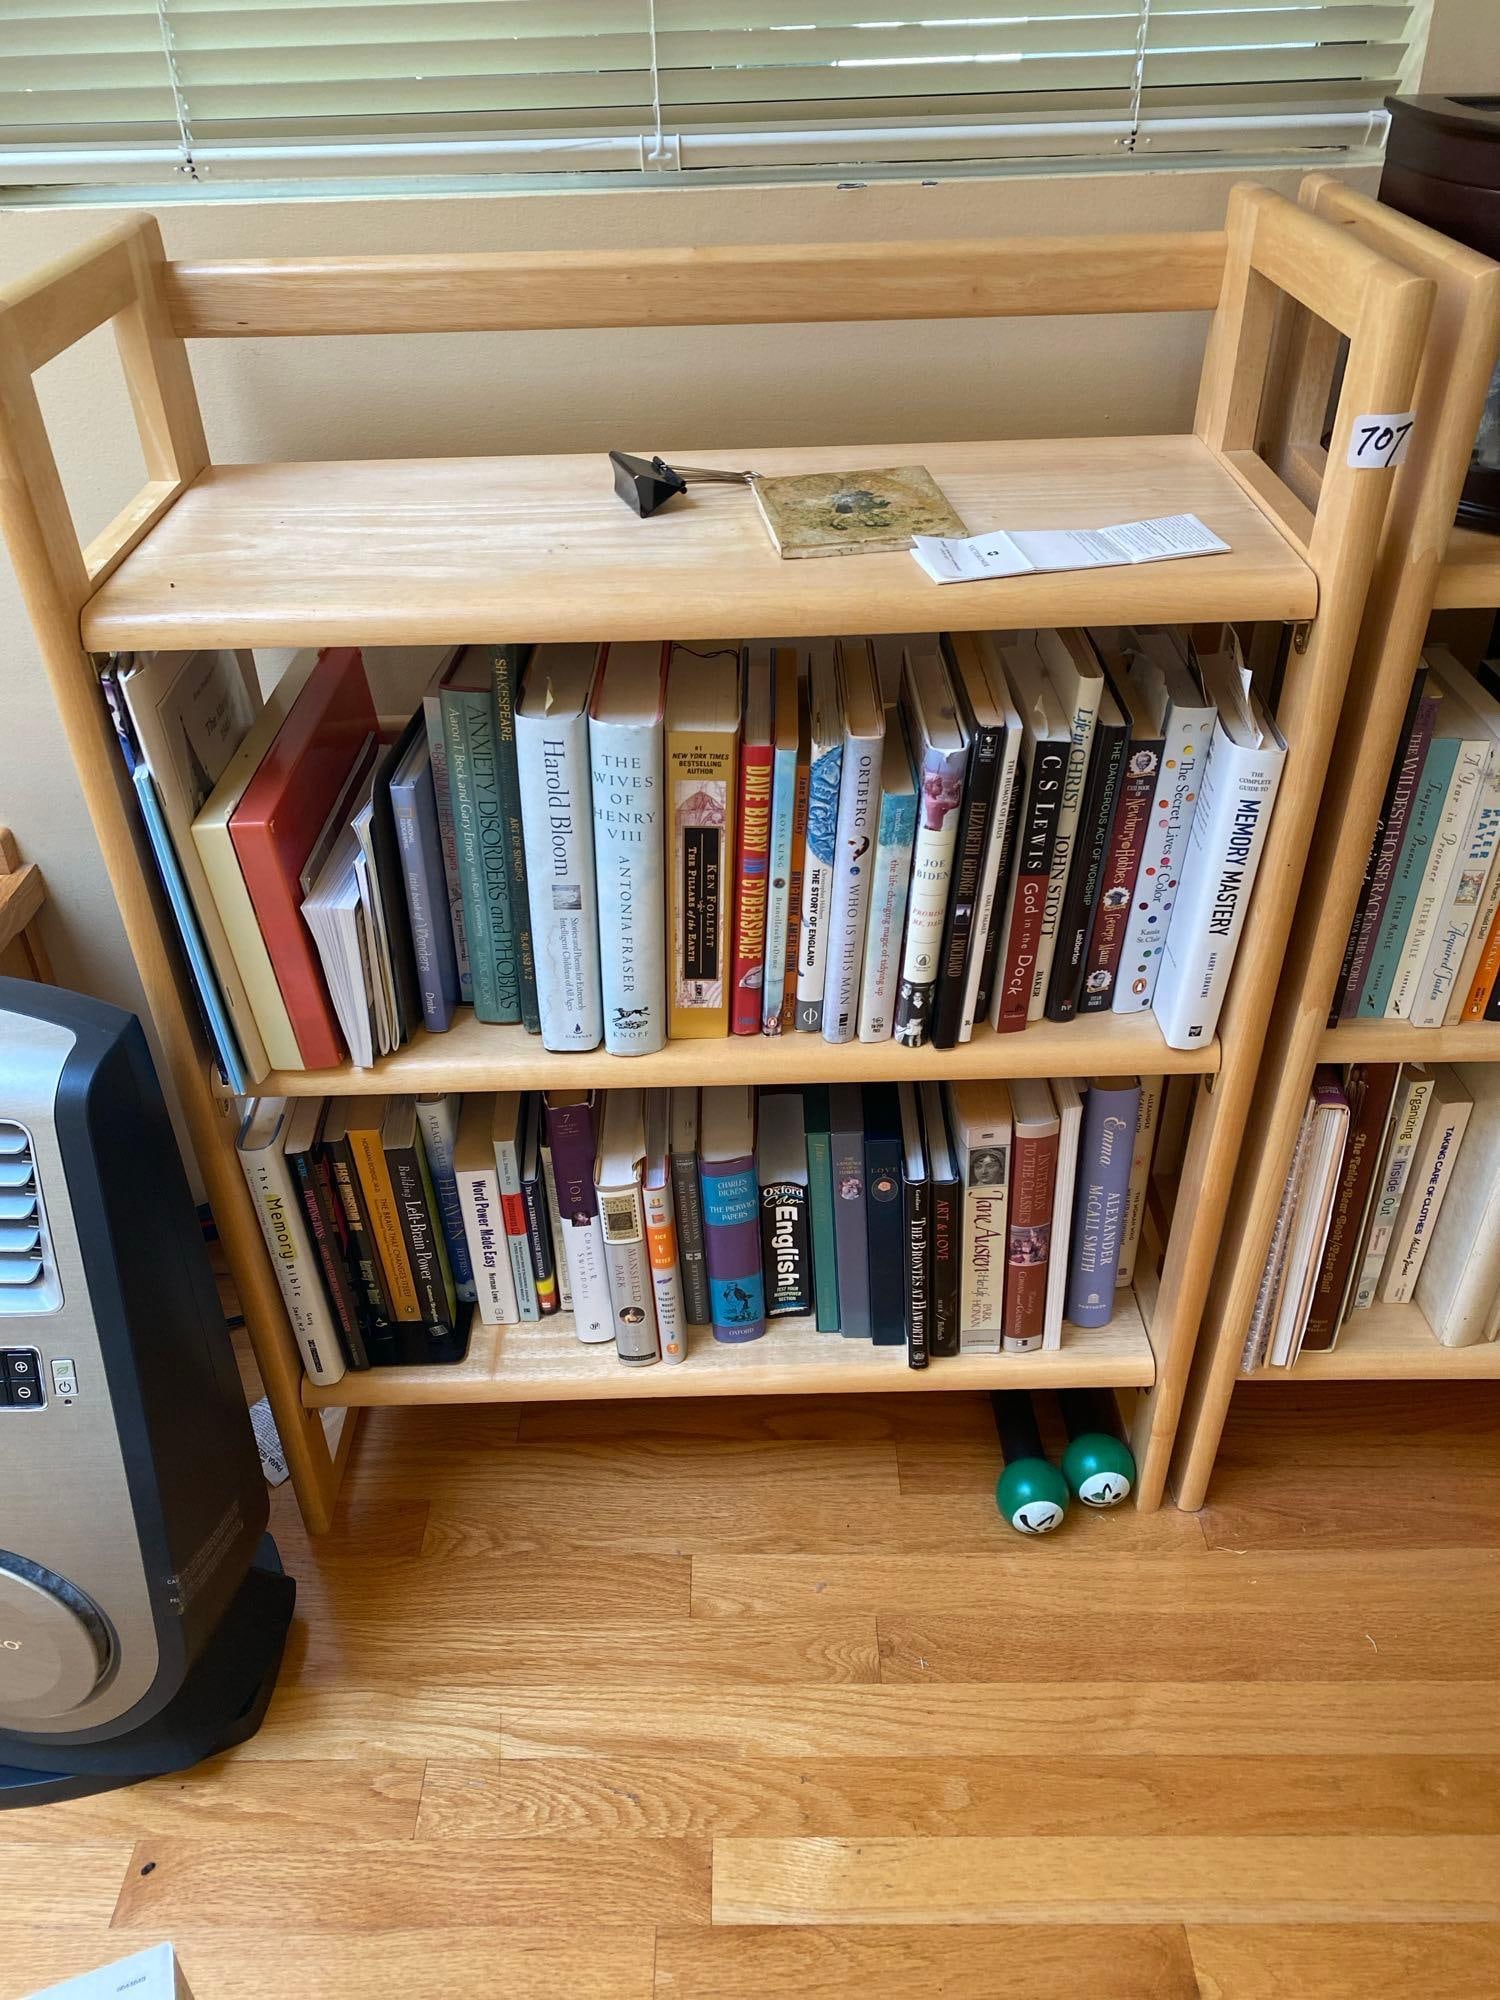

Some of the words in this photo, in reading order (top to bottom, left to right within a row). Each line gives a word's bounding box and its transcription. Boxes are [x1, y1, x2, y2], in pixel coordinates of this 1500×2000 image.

[1357, 421, 1413, 467] 707
[495, 659, 512, 741] SHAKESPEARE
[449, 707, 461, 742] Aaron
[1072, 707, 1094, 732] Life
[467, 704, 497, 795] ANXIETY
[1110, 741, 1123, 761] THE
[1406, 730, 1422, 755] THE
[455, 754, 468, 780] Beck
[543, 739, 570, 808] Harold
[601, 755, 641, 769] THE
[1178, 758, 1195, 782] The
[457, 783, 471, 805] and
[594, 771, 654, 788] WIVES
[745, 765, 770, 801] DAVE
[855, 756, 872, 827] ORTBERG
[1062, 749, 1086, 812] CHRIST
[1099, 763, 1119, 824] DANGEROUS
[1239, 777, 1272, 785] COMPLETE
[1387, 754, 1418, 828] WILDEST
[1453, 772, 1475, 803] Year
[610, 794, 634, 805] OF
[1171, 784, 1190, 821] Secret
[460, 804, 473, 831] Gary
[595, 807, 656, 824] HENRY
[744, 807, 769, 852] BARRY
[965, 802, 987, 855] ELIZABETH
[1118, 798, 1146, 842] Newbury
[464, 832, 475, 864] Emery
[550, 815, 572, 876] Bloom
[608, 828, 642, 842] VIII
[1027, 802, 1055, 869] LEWIS
[1096, 826, 1106, 846] ACT
[1161, 826, 1180, 855] Lives
[1225, 799, 1262, 866] MEMORY
[1469, 808, 1492, 859] MAYLE
[478, 801, 508, 901] DISORDERS
[688, 846, 698, 869] THE
[777, 843, 785, 868] KING
[923, 858, 946, 868] JOE
[1050, 835, 1070, 881] JOHN
[1092, 848, 1102, 861] OF
[1114, 849, 1136, 884] Hobbes
[1374, 828, 1399, 880] HORSE
[1428, 833, 1457, 883] Provence
[688, 870, 697, 908] PILLARS
[706, 864, 717, 890] KEN
[812, 868, 820, 885] THE
[916, 869, 951, 880] BIDEN
[959, 858, 977, 897] GEORGE
[1084, 863, 1099, 906] WORSHIP
[1152, 873, 1170, 903] Color
[618, 856, 632, 931] ANTONIA
[808, 886, 820, 914] STORY
[848, 884, 860, 918] WHO
[884, 875, 898, 928] life-changing
[1024, 882, 1039, 913] God
[1209, 871, 1244, 936] MASTERY
[1363, 881, 1384, 922] RACE
[1392, 896, 1407, 922] PETER
[491, 906, 512, 935] and
[706, 896, 716, 948] FOLLETT
[739, 879, 765, 959] CYBERSPACE
[1024, 920, 1032, 928] in
[1041, 885, 1062, 938] STOTT
[1420, 896, 1436, 926] PETER
[845, 924, 856, 936] IS
[1020, 932, 1031, 949] the
[1384, 924, 1398, 950] MAYLE
[1408, 926, 1427, 959] MAYLE
[688, 934, 696, 962] EARTH
[806, 928, 816, 967] ENGLAND
[843, 943, 855, 972] THIS
[948, 939, 967, 977] RICHARD
[1071, 929, 1085, 965] Labberton
[1440, 920, 1469, 972] Acquired
[494, 939, 519, 1010] PHOBIAS
[622, 937, 635, 992] FRASER
[1007, 955, 1033, 995] Dock
[1208, 952, 1218, 972] HARRY
[1345, 955, 1363, 991] WORLD
[840, 977, 852, 1005] MAN
[1032, 971, 1044, 997] BAKER
[1200, 973, 1214, 998] LORAYNE
[1430, 968, 1454, 1001] Tastes
[563, 1114, 570, 1123] 7
[1400, 1086, 1427, 1140] Organizing
[1100, 1116, 1127, 1167] Emma
[1352, 1134, 1367, 1155] The
[1437, 1126, 1455, 1161] TAKING
[399, 1165, 415, 1198] Building
[430, 1121, 442, 1145] PLACE
[438, 1179, 465, 1241] HEAVEN
[717, 1179, 747, 1189] CHARLES
[1034, 1152, 1051, 1210] INVITATION
[1386, 1160, 1406, 1193] Inside
[1429, 1160, 1443, 1184] CARE
[472, 1180, 488, 1202] Word
[567, 1180, 582, 1202] JOB
[718, 1186, 748, 1197] DICKENS
[763, 1185, 803, 1197] Oxford
[764, 1195, 805, 1208] Color
[1020, 1175, 1034, 1224] CLASSICS
[1380, 1197, 1395, 1215] Out
[1426, 1186, 1435, 1197] OF
[475, 1203, 489, 1227] Power
[709, 1205, 723, 1214] THE
[721, 1211, 748, 1222] PAPERS
[937, 1199, 950, 1220] ART
[968, 1190, 1004, 1224] Jane
[1085, 1184, 1105, 1232] McCALL
[1414, 1196, 1434, 1235] CLOTHES
[257, 1167, 268, 1190] The
[267, 1198, 294, 1259] Memory
[286, 1264, 301, 1297] Bible
[405, 1200, 427, 1250] Left-Brain
[480, 1230, 495, 1250] Made
[911, 1217, 926, 1240] THE
[1100, 1192, 1121, 1266] ALEXANDER
[383, 1212, 392, 1231] BRAIN
[392, 1250, 407, 1282] CHANGES
[483, 1251, 497, 1271] Easy
[772, 1206, 799, 1286] English
[937, 1235, 949, 1260] LOVE
[1080, 1235, 1098, 1273] SMITH
[416, 1252, 432, 1280] Power
[489, 1273, 497, 1290] Norman
[577, 1253, 590, 1299] SWINDOLL
[616, 1265, 625, 1288] PARK
[628, 1248, 641, 1302] MANSFIELD
[491, 1290, 499, 1303] Lewis
[912, 1288, 923, 1298] AT
[1321, 1271, 1334, 1293] Bull
[912, 1301, 926, 1345] HAWORTH
[970, 1300, 981, 1328] HONAN
[982, 1304, 992, 1322] PARK
[729, 1327, 754, 1336] OXFORD
